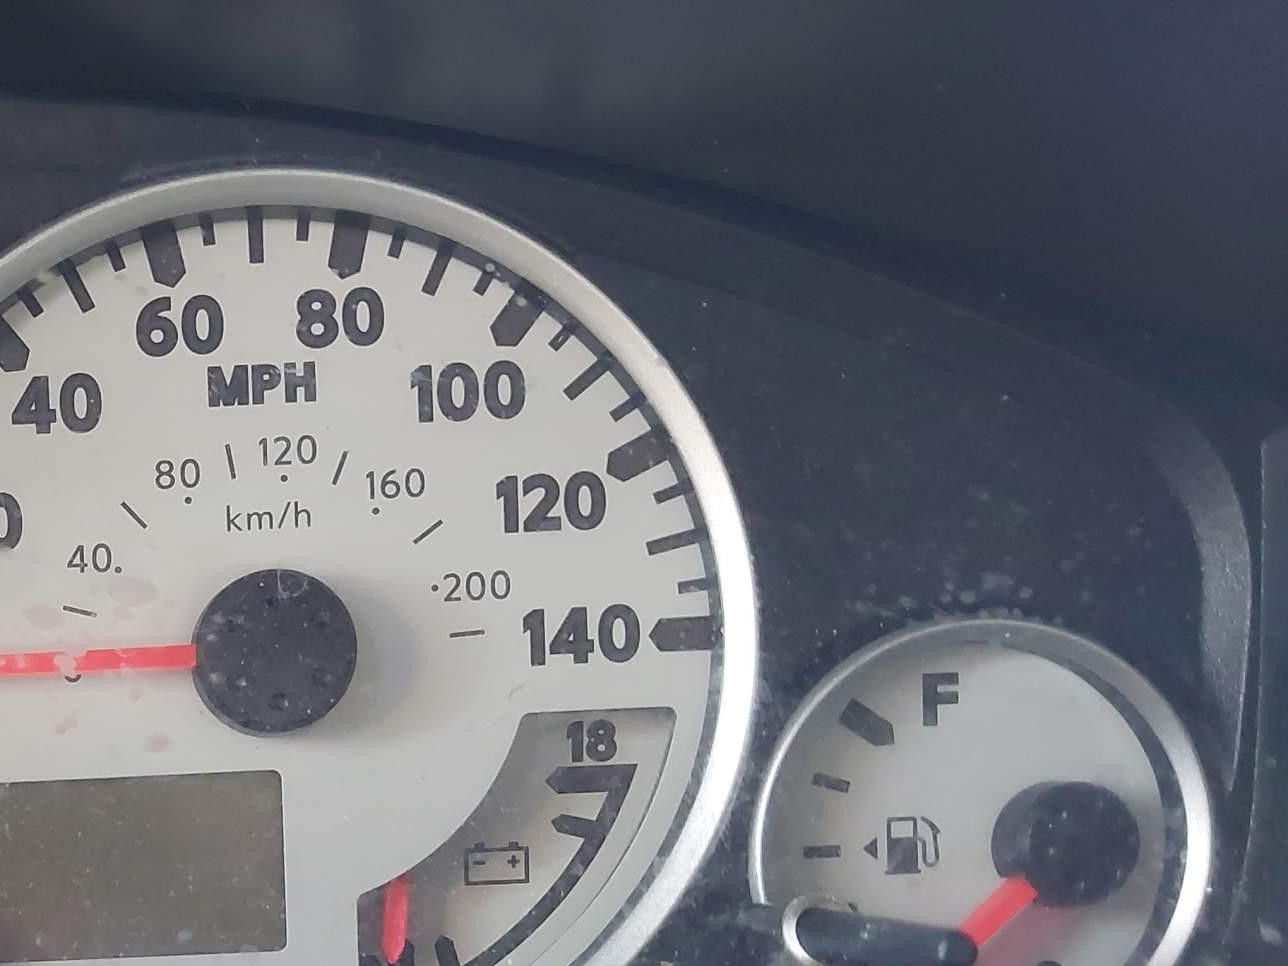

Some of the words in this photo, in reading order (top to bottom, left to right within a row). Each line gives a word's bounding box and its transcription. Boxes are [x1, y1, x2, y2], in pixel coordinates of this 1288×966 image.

[135, 294, 225, 358] 60
[295, 286, 385, 350] 80
[10, 372, 103, 435] 40
[206, 360, 317, 408] MPH
[410, 359, 528, 423] 100
[155, 458, 201, 490] 80
[258, 434, 317, 467] 120
[365, 467, 426, 500] 160
[495, 470, 608, 534] 120
[224, 500, 313, 533] km/h
[66, 542, 112, 575] 40
[443, 570, 511, 603] 200
[522, 604, 641, 668] 140
[921, 672, 960, 727] F
[566, 719, 618, 763] 18
